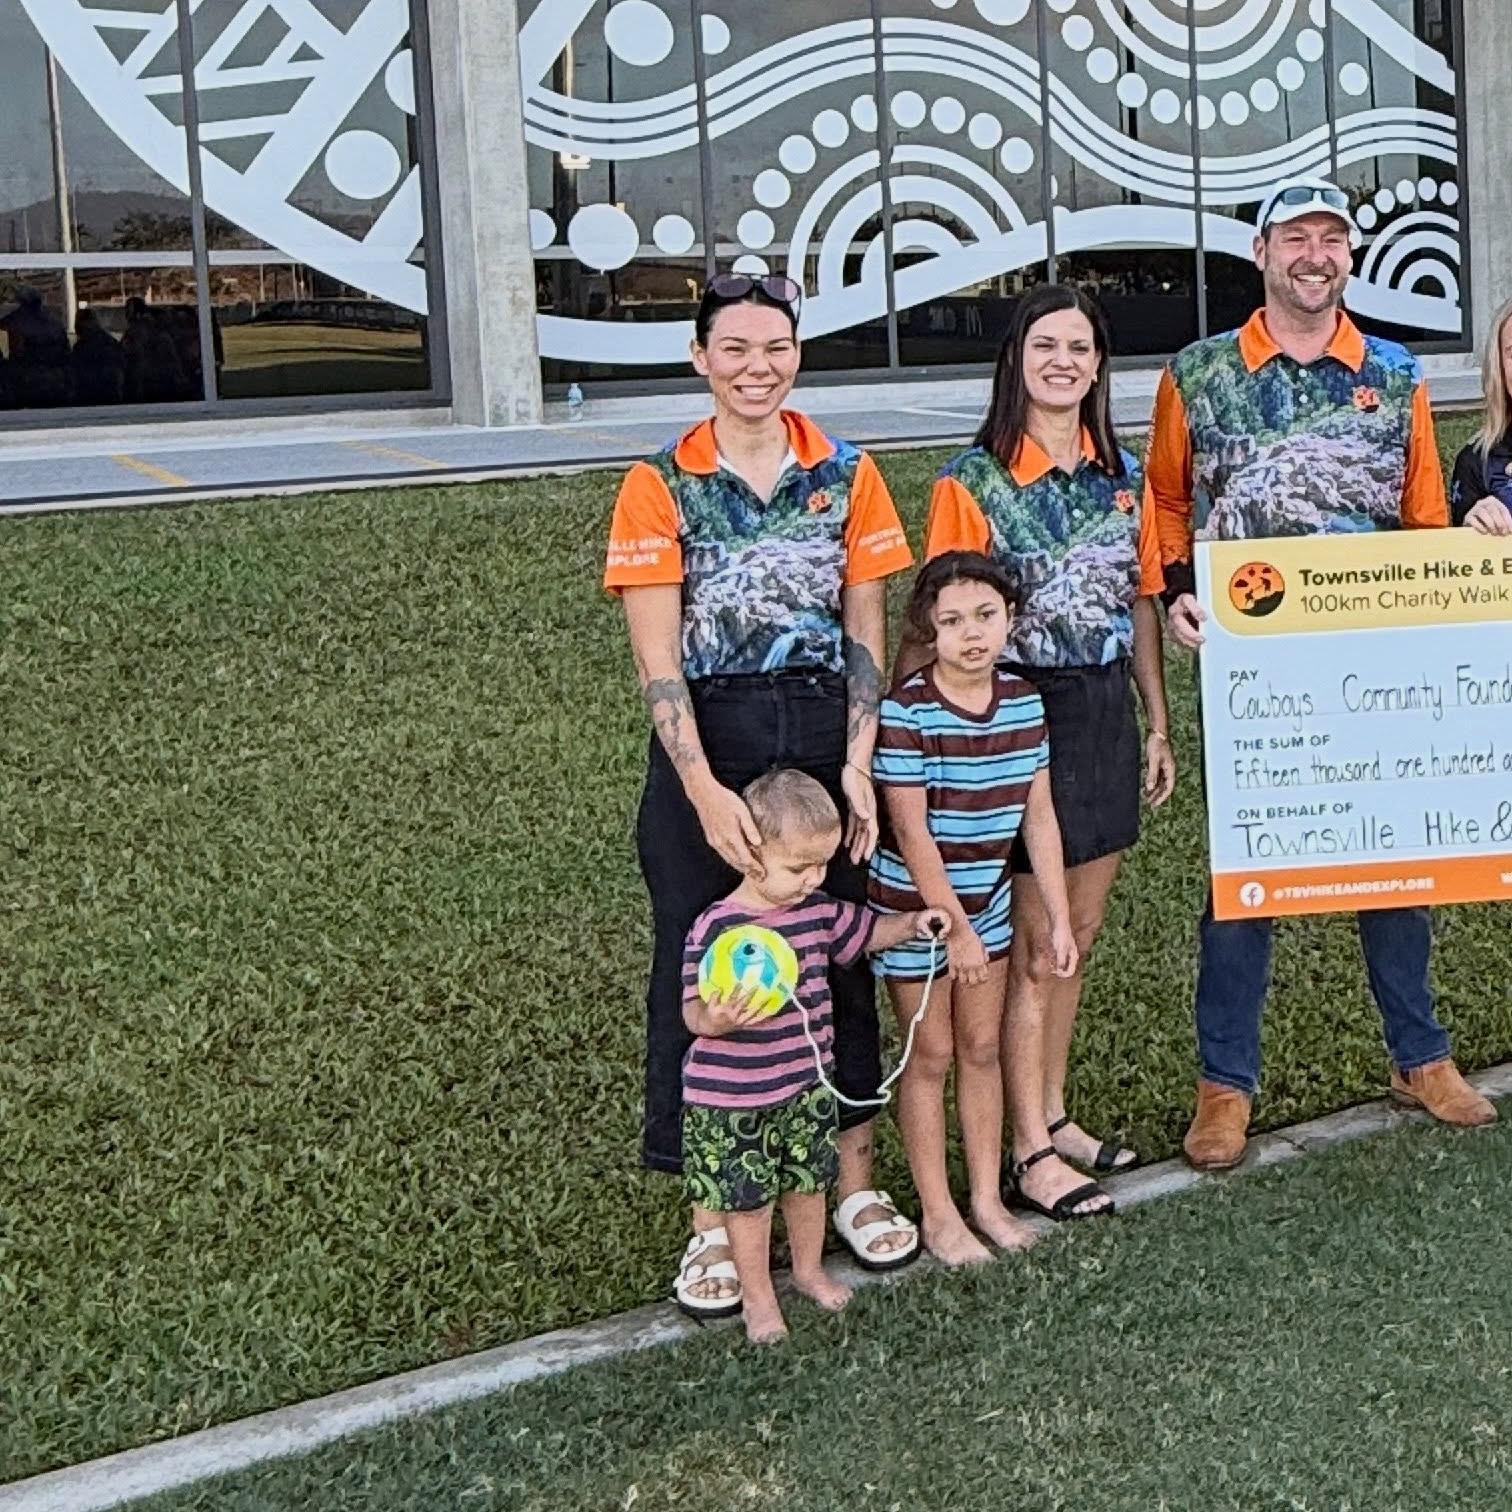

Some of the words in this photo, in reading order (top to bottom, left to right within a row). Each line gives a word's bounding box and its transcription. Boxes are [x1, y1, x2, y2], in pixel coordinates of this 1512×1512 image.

[1299, 563, 1416, 587] Townsville
[1424, 561, 1473, 580] Hike
[1480, 558, 1495, 576] &
[1300, 592, 1371, 614] 100km
[1377, 589, 1451, 610] Charity
[1459, 585, 1509, 604] Walk
[1230, 670, 1259, 682] PAY
[1229, 680, 1314, 733] Cowboys
[1343, 672, 1444, 722] Community
[1234, 739, 1264, 752] THE
[1270, 737, 1304, 750] SUM
[1310, 735, 1331, 748] OF
[1234, 758, 1300, 789] Fifteen
[1310, 750, 1382, 784] thousand
[1395, 755, 1426, 778] one
[1430, 741, 1496, 777] hundred
[1237, 808, 1260, 820] ON
[1266, 804, 1327, 819] BEHALF
[1332, 802, 1354, 815] OF
[1231, 815, 1395, 858] Townsville
[1425, 810, 1480, 847] Hike
